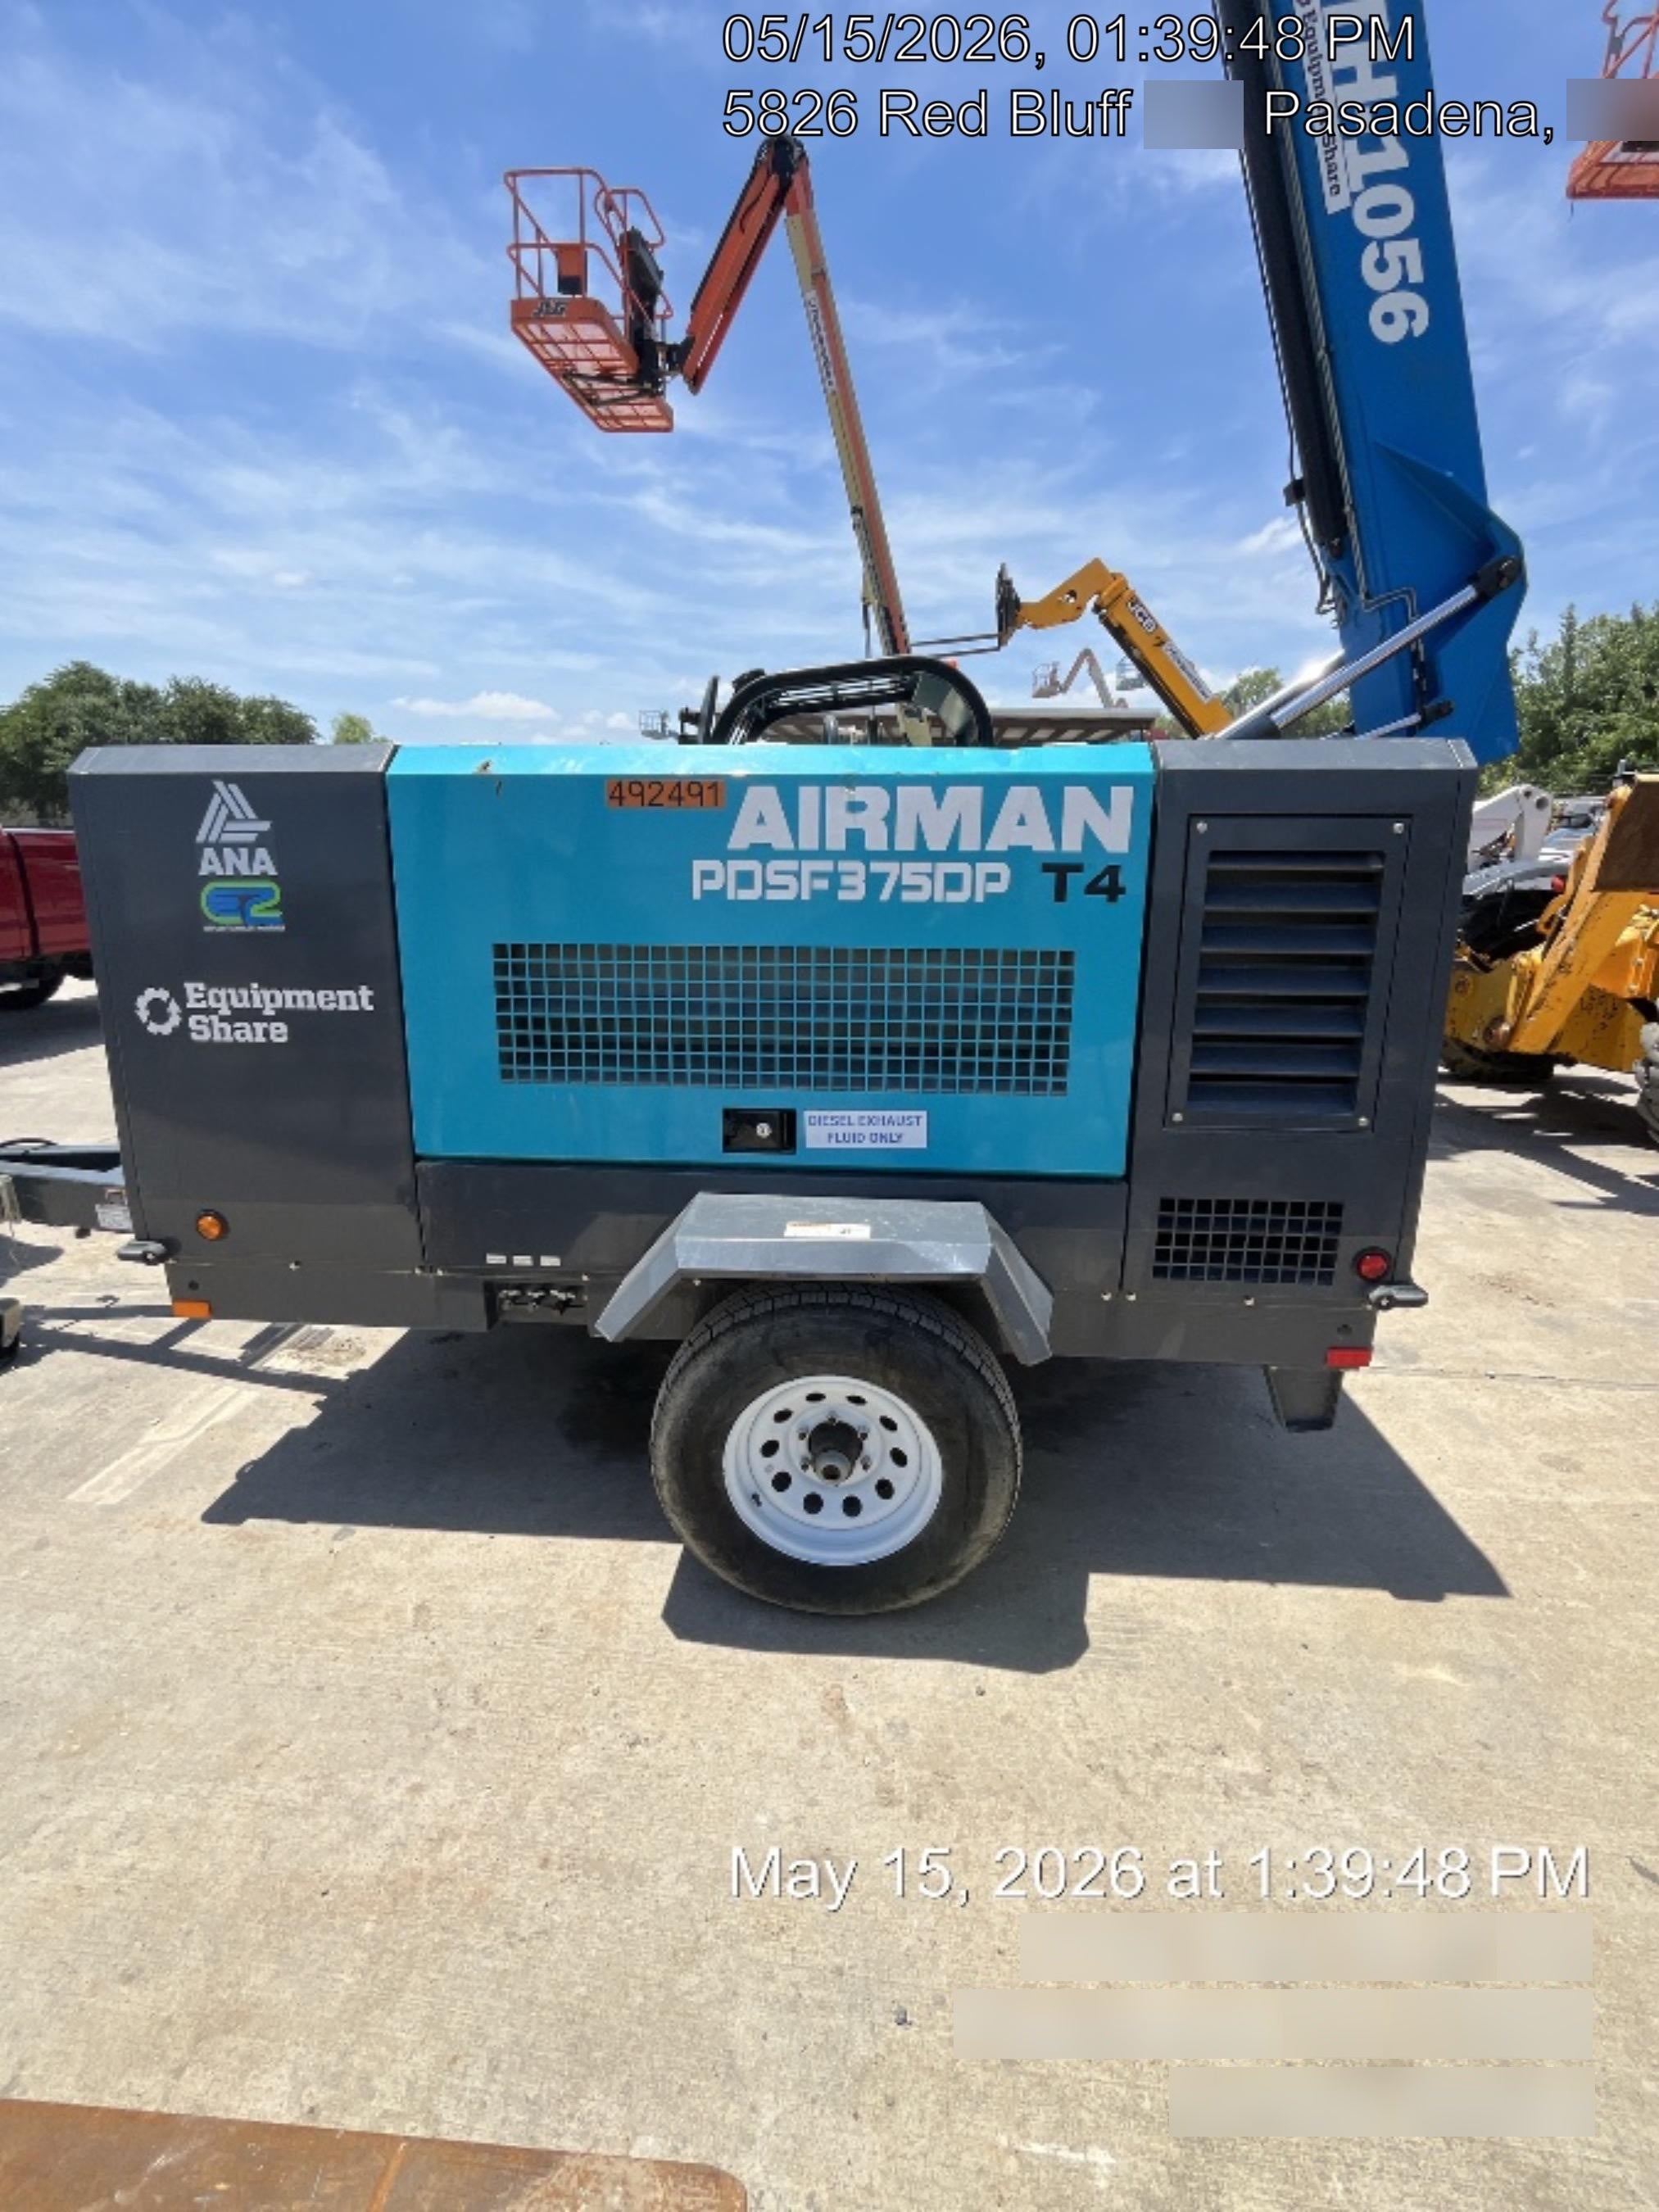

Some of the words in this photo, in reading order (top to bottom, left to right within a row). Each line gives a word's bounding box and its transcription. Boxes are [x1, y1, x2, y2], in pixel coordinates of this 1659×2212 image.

[609, 780, 720, 807] 492491
[727, 786, 1134, 853] AIRMAN
[198, 847, 278, 875] ANA
[691, 859, 1011, 902] PDSF375DP
[1041, 863, 1126, 903] T4
[184, 982, 374, 1015] Equipment
[188, 1014, 288, 1042] Share
[808, 1115, 854, 1126] DIESEL
[858, 1115, 922, 1126] EXHAUST
[827, 1132, 866, 1144] FLUID
[869, 1132, 904, 1144] ONLY
